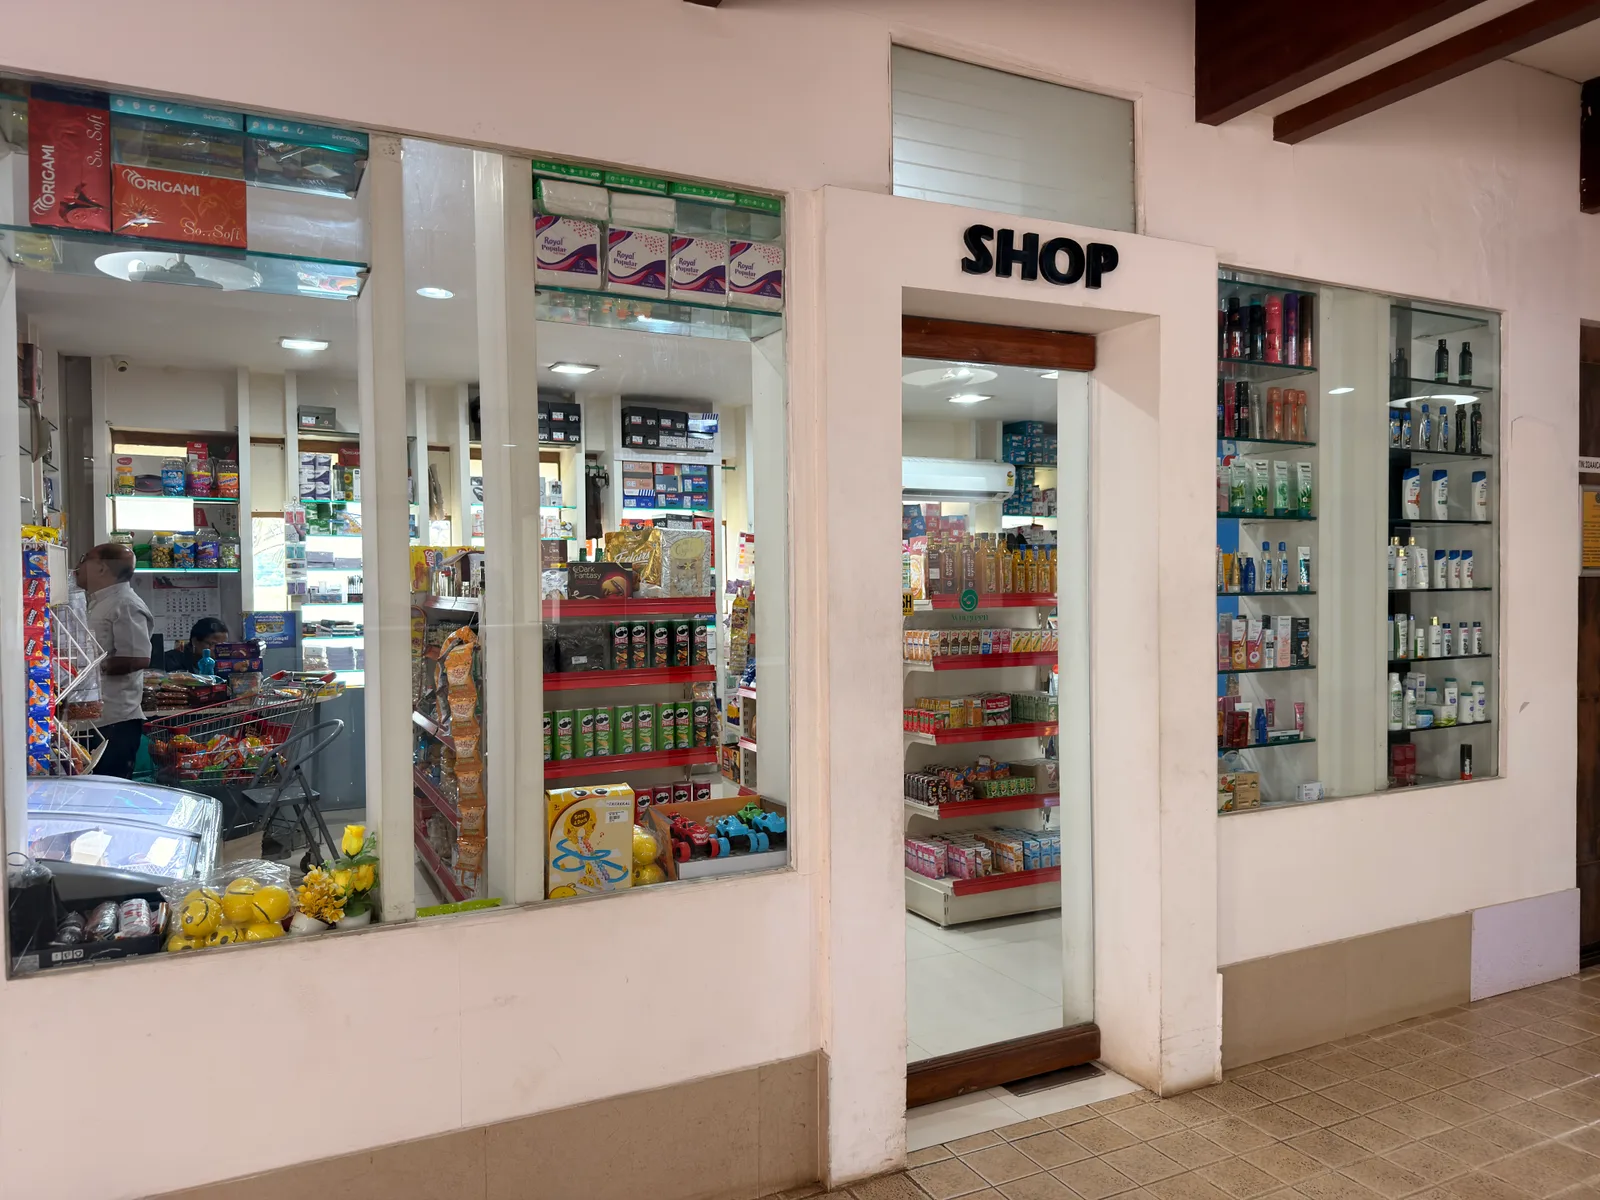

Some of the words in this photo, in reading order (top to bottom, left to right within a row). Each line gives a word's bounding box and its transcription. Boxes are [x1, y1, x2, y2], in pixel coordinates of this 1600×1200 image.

[40, 145, 56, 208] ORIGAMI
[131, 174, 200, 197] ORIGAMI
[544, 236, 564, 246] Royal
[541, 244, 567, 253] Popular
[616, 250, 635, 260] Royal
[961, 224, 1119, 289] SHOP
[614, 258, 638, 267] Popular
[678, 257, 696, 266] Royal
[737, 261, 755, 270] Royal
[734, 268, 756, 277] Popular
[578, 565, 595, 573] Dark
[574, 572, 601, 580] Fantasy
[27, 608, 37, 626] BOOST
[26, 637, 36, 656] BOOST
